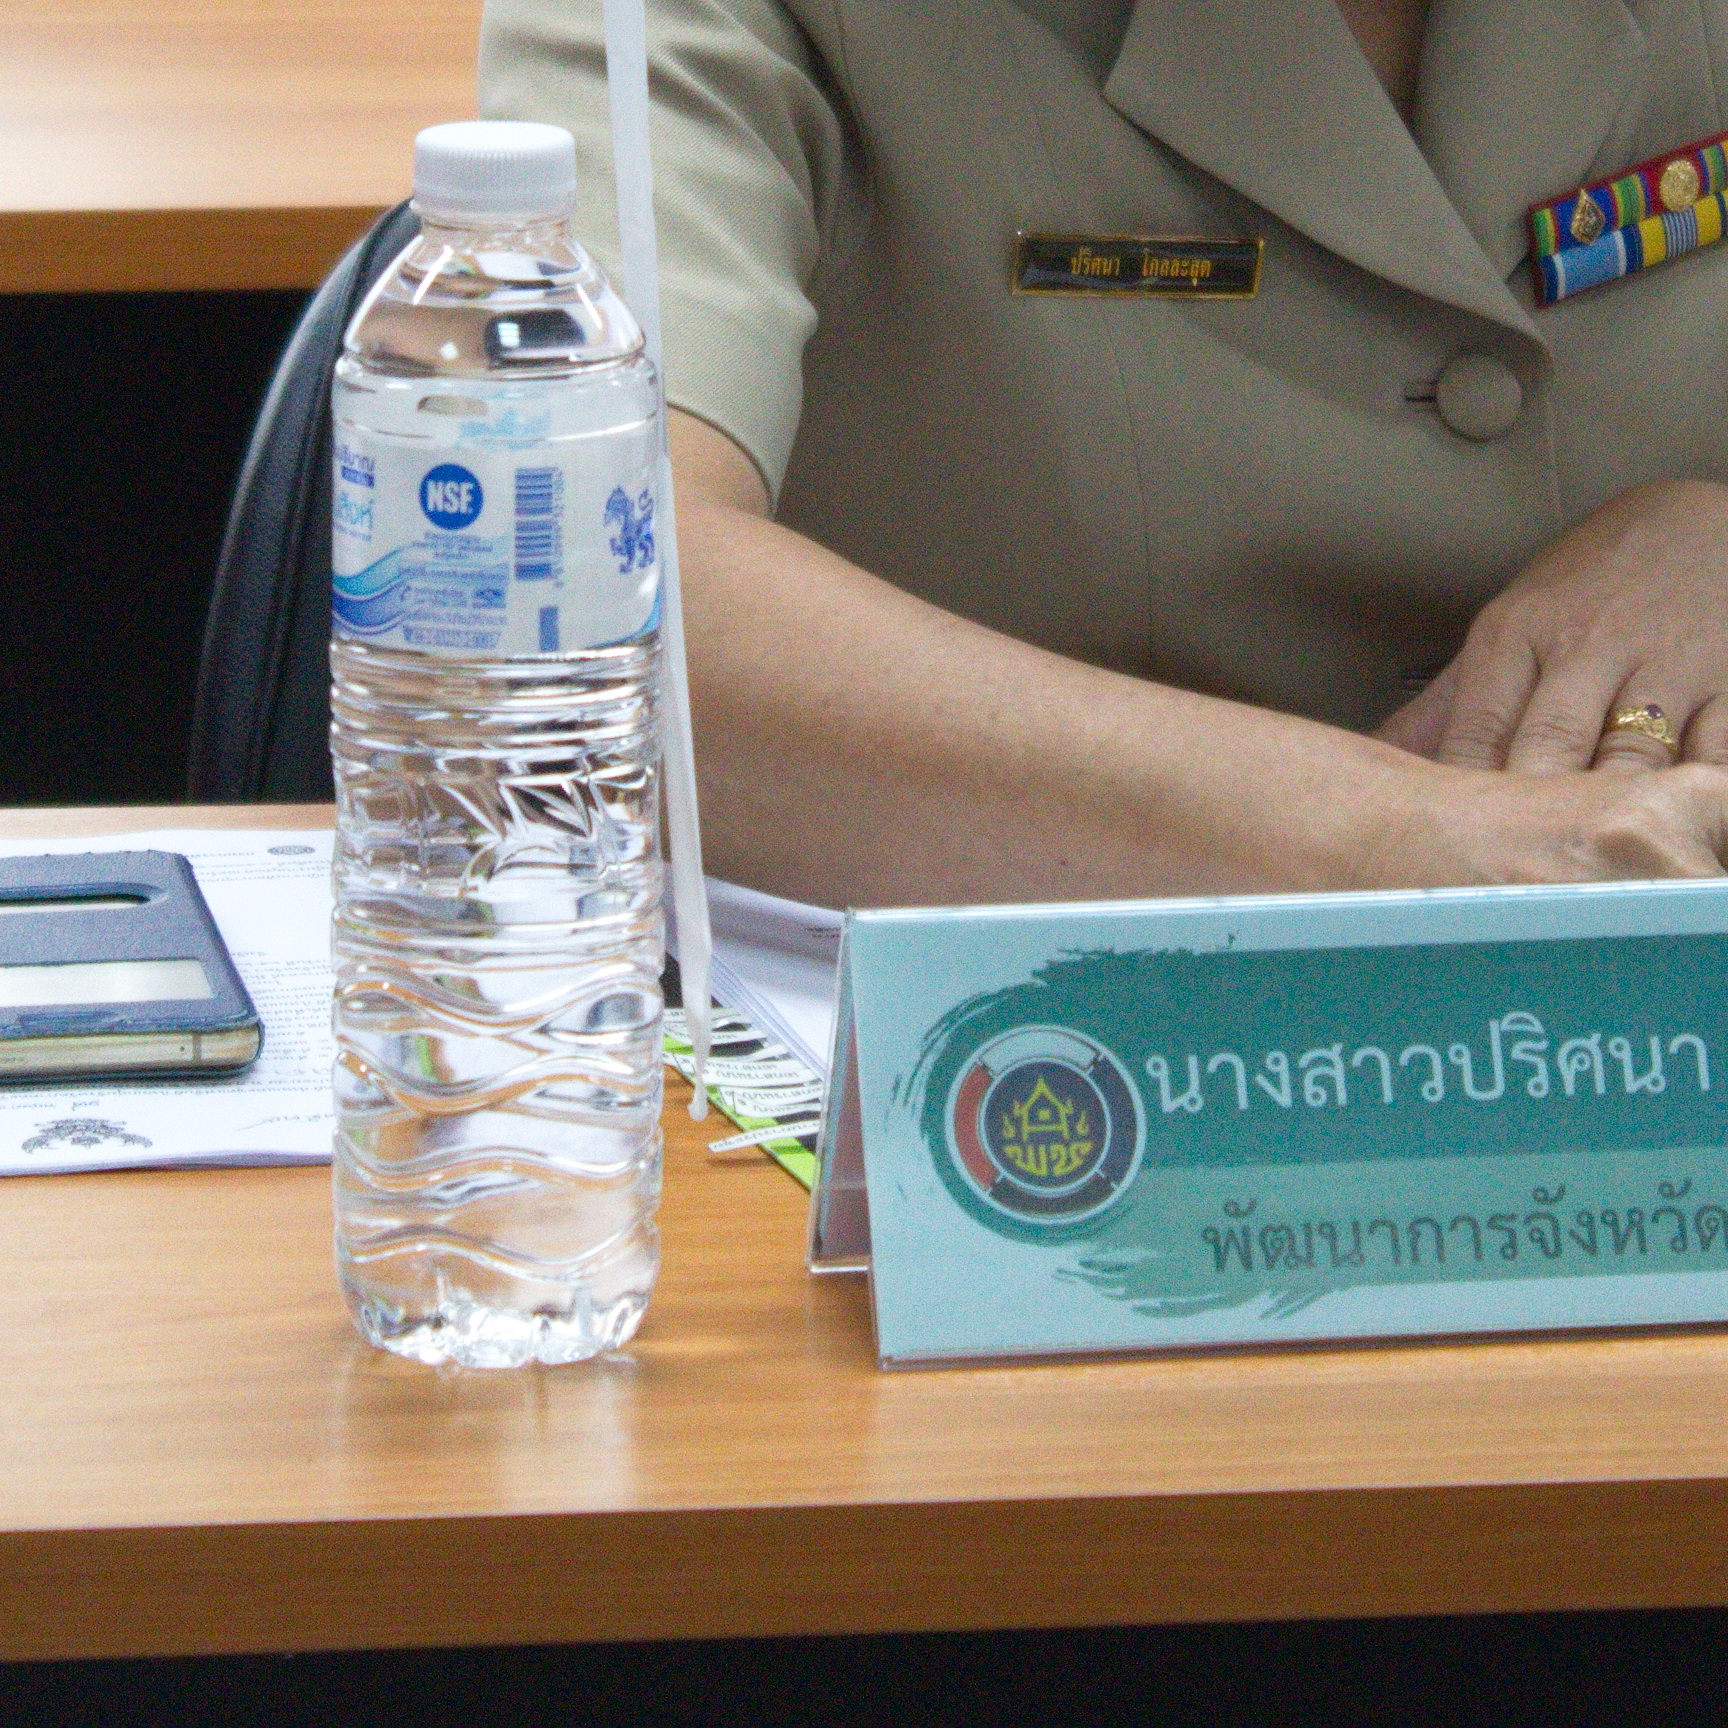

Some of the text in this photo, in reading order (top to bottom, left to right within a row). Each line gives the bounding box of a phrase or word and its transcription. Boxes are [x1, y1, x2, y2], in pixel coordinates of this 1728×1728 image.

[426, 479, 475, 513] NSF
[1144, 1010, 1712, 1114] นางสาวปริศนา
